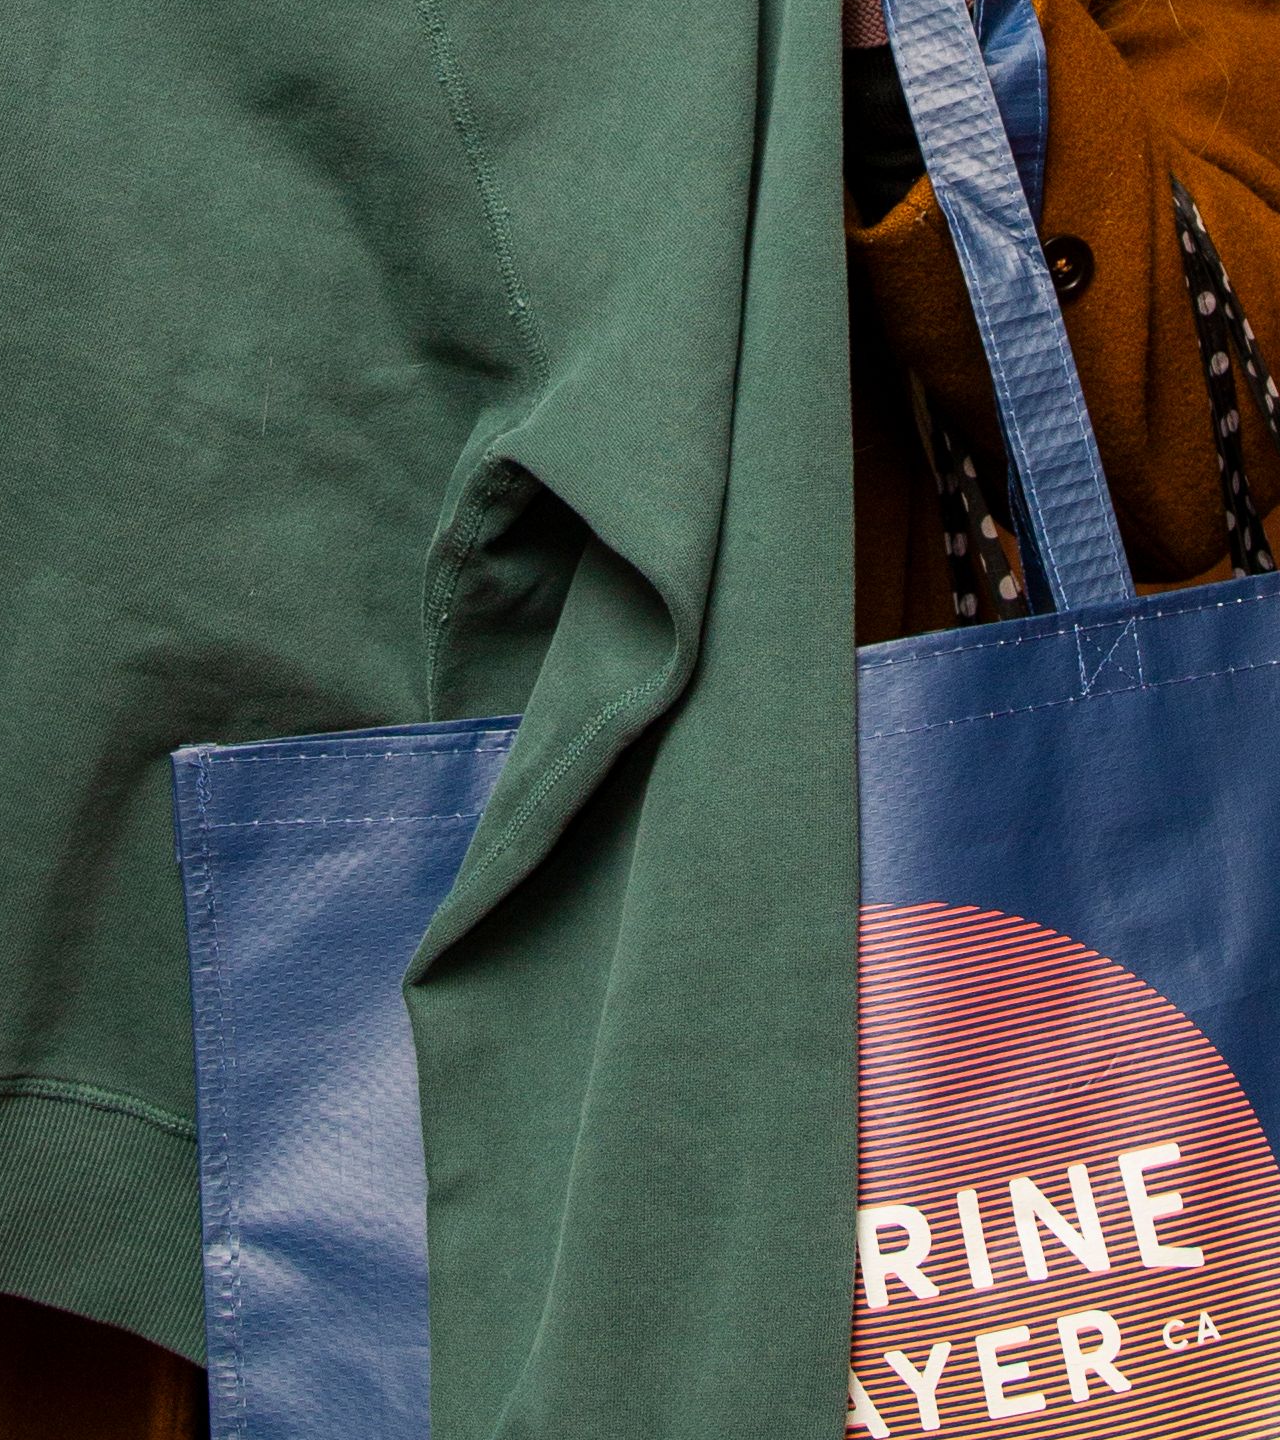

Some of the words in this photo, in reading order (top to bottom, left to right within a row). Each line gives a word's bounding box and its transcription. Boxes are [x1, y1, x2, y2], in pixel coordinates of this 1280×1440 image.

[857, 1142, 1205, 1309] RINE
[846, 1309, 1132, 1439] AYER
[1162, 1311, 1222, 1351] CA
